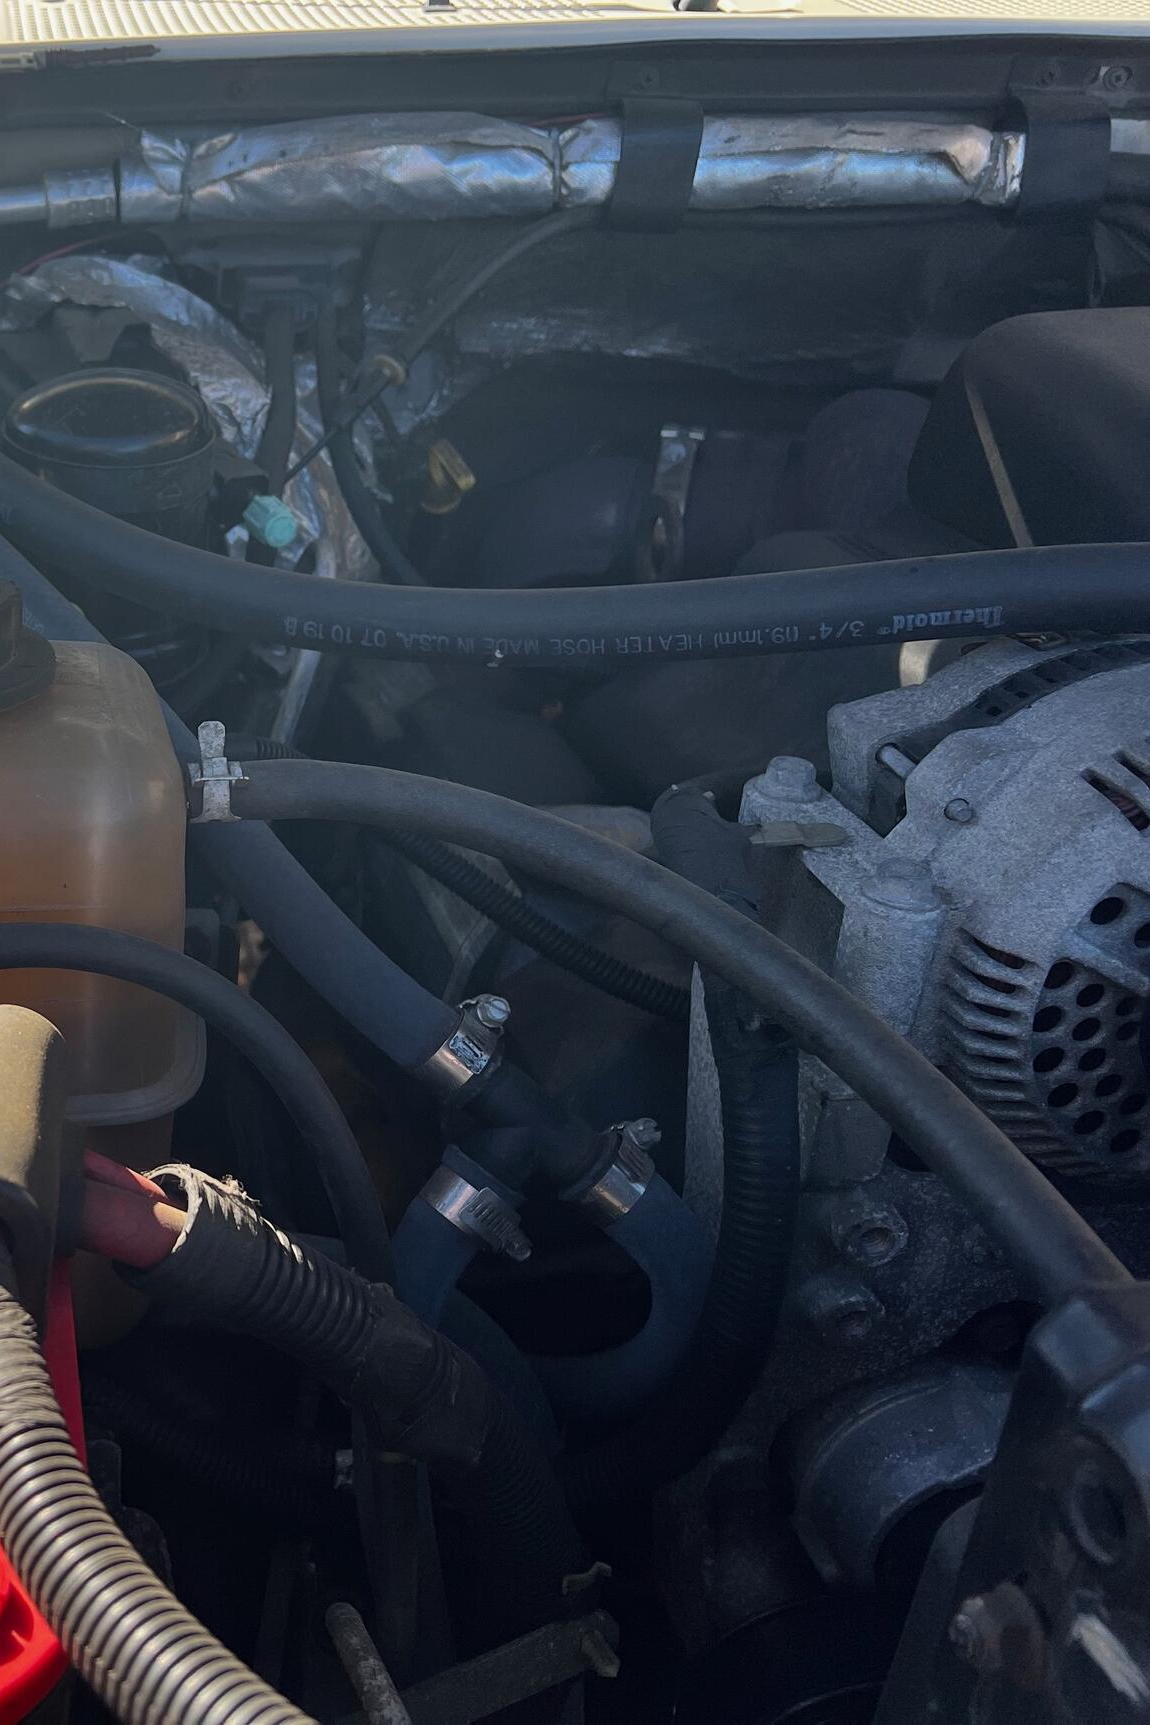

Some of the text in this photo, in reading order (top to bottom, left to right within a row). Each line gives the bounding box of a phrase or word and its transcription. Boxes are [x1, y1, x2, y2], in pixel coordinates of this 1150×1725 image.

[457, 636, 474, 653] IN
[482, 637, 539, 655] MADE
[550, 638, 605, 654] HOSE
[615, 633, 703, 653] HEATER
